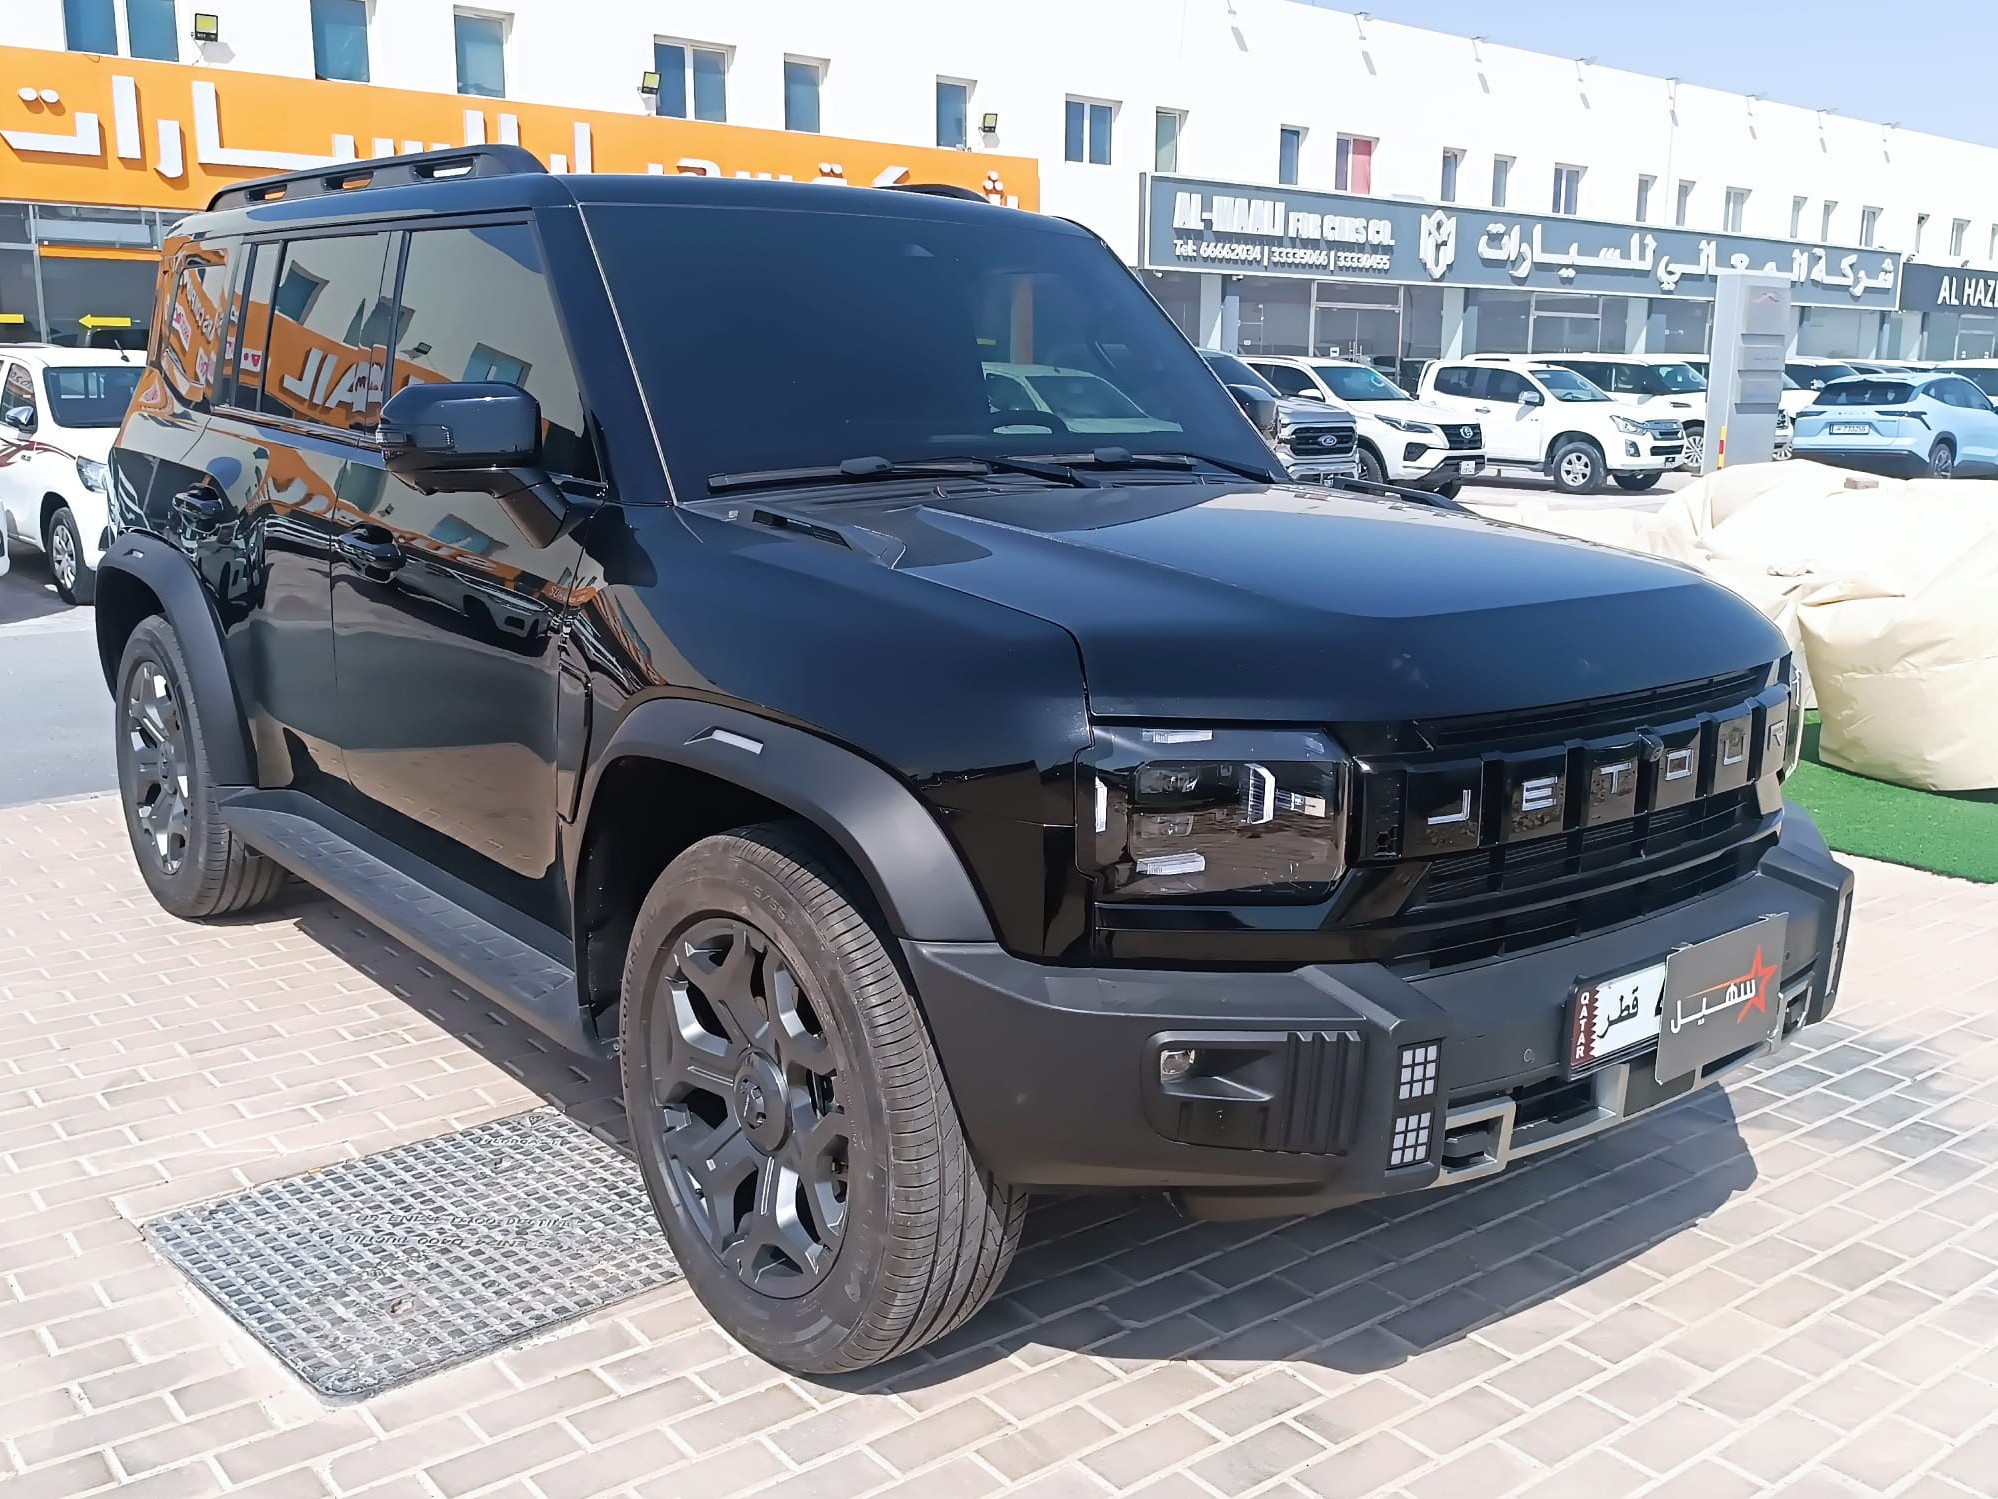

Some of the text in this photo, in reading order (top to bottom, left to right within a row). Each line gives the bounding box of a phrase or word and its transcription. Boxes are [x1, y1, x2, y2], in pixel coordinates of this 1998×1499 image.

[1288, 211, 1322, 239] FOR
[1322, 215, 1367, 244] CARS
[1478, 223, 1893, 297] شركة المعالي للسيارات
[1936, 275, 1998, 308] AL HAZ
[1427, 720, 1785, 826] JETOUR
[1575, 991, 1591, 1060] QATAR
[1597, 985, 1639, 1039] قطر
[1670, 978, 1756, 1034] سهيل
